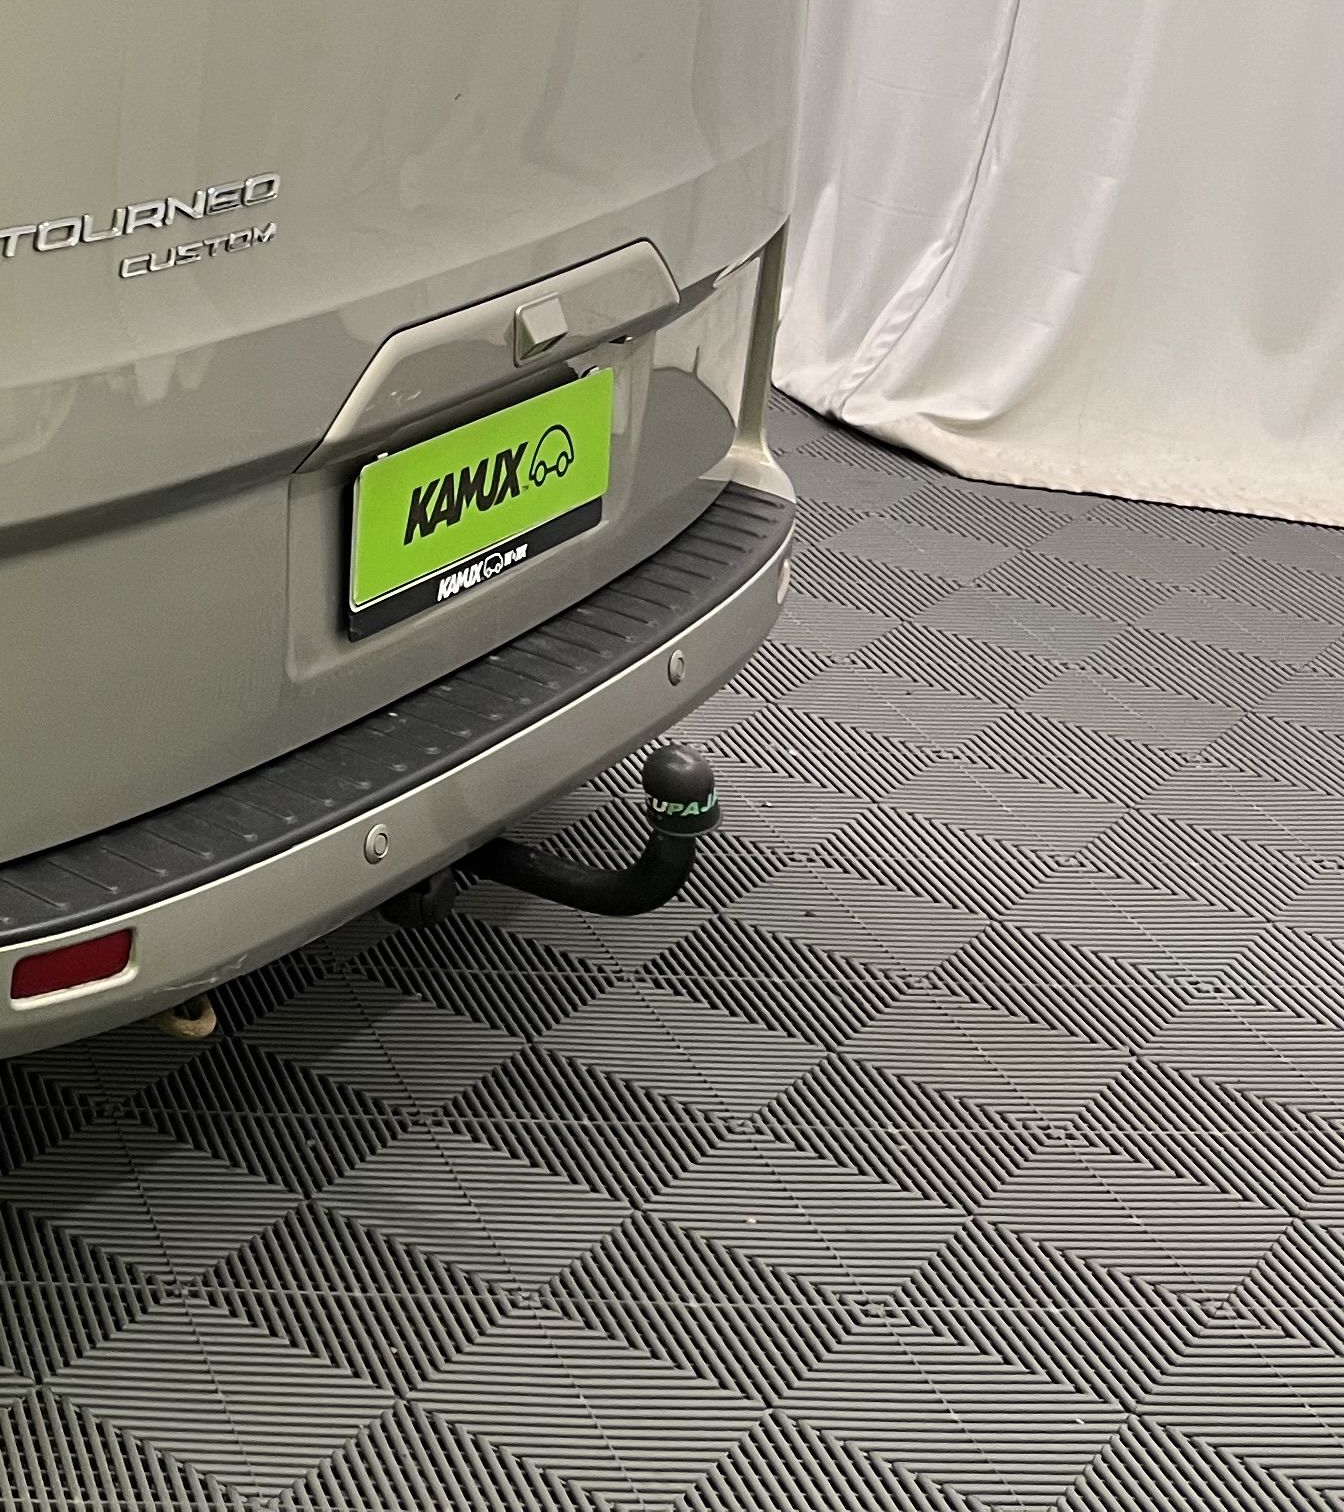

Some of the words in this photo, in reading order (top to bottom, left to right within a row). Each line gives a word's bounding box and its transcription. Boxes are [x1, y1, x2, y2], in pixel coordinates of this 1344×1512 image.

[119, 222, 278, 279] CUSTOM
[403, 441, 529, 546] KAMUX
[436, 561, 484, 602] KAMUX
